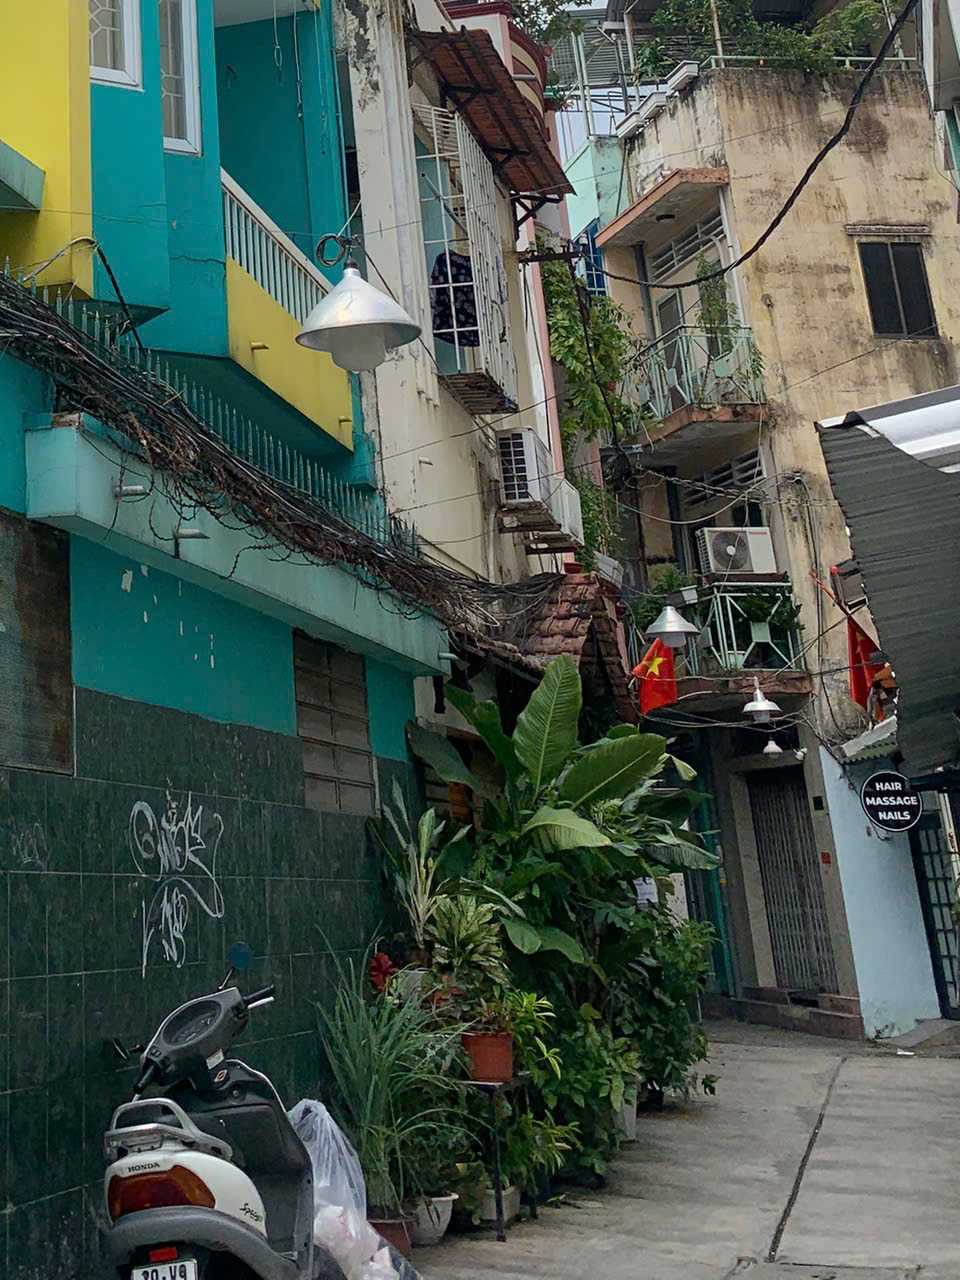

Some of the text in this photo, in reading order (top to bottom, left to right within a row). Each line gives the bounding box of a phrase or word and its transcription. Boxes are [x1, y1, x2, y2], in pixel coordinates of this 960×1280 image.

[875, 782, 902, 791] HAIR
[866, 797, 918, 806] MASSAGE
[878, 811, 910, 820] NAILS
[128, 1162, 160, 1173] HONDA
